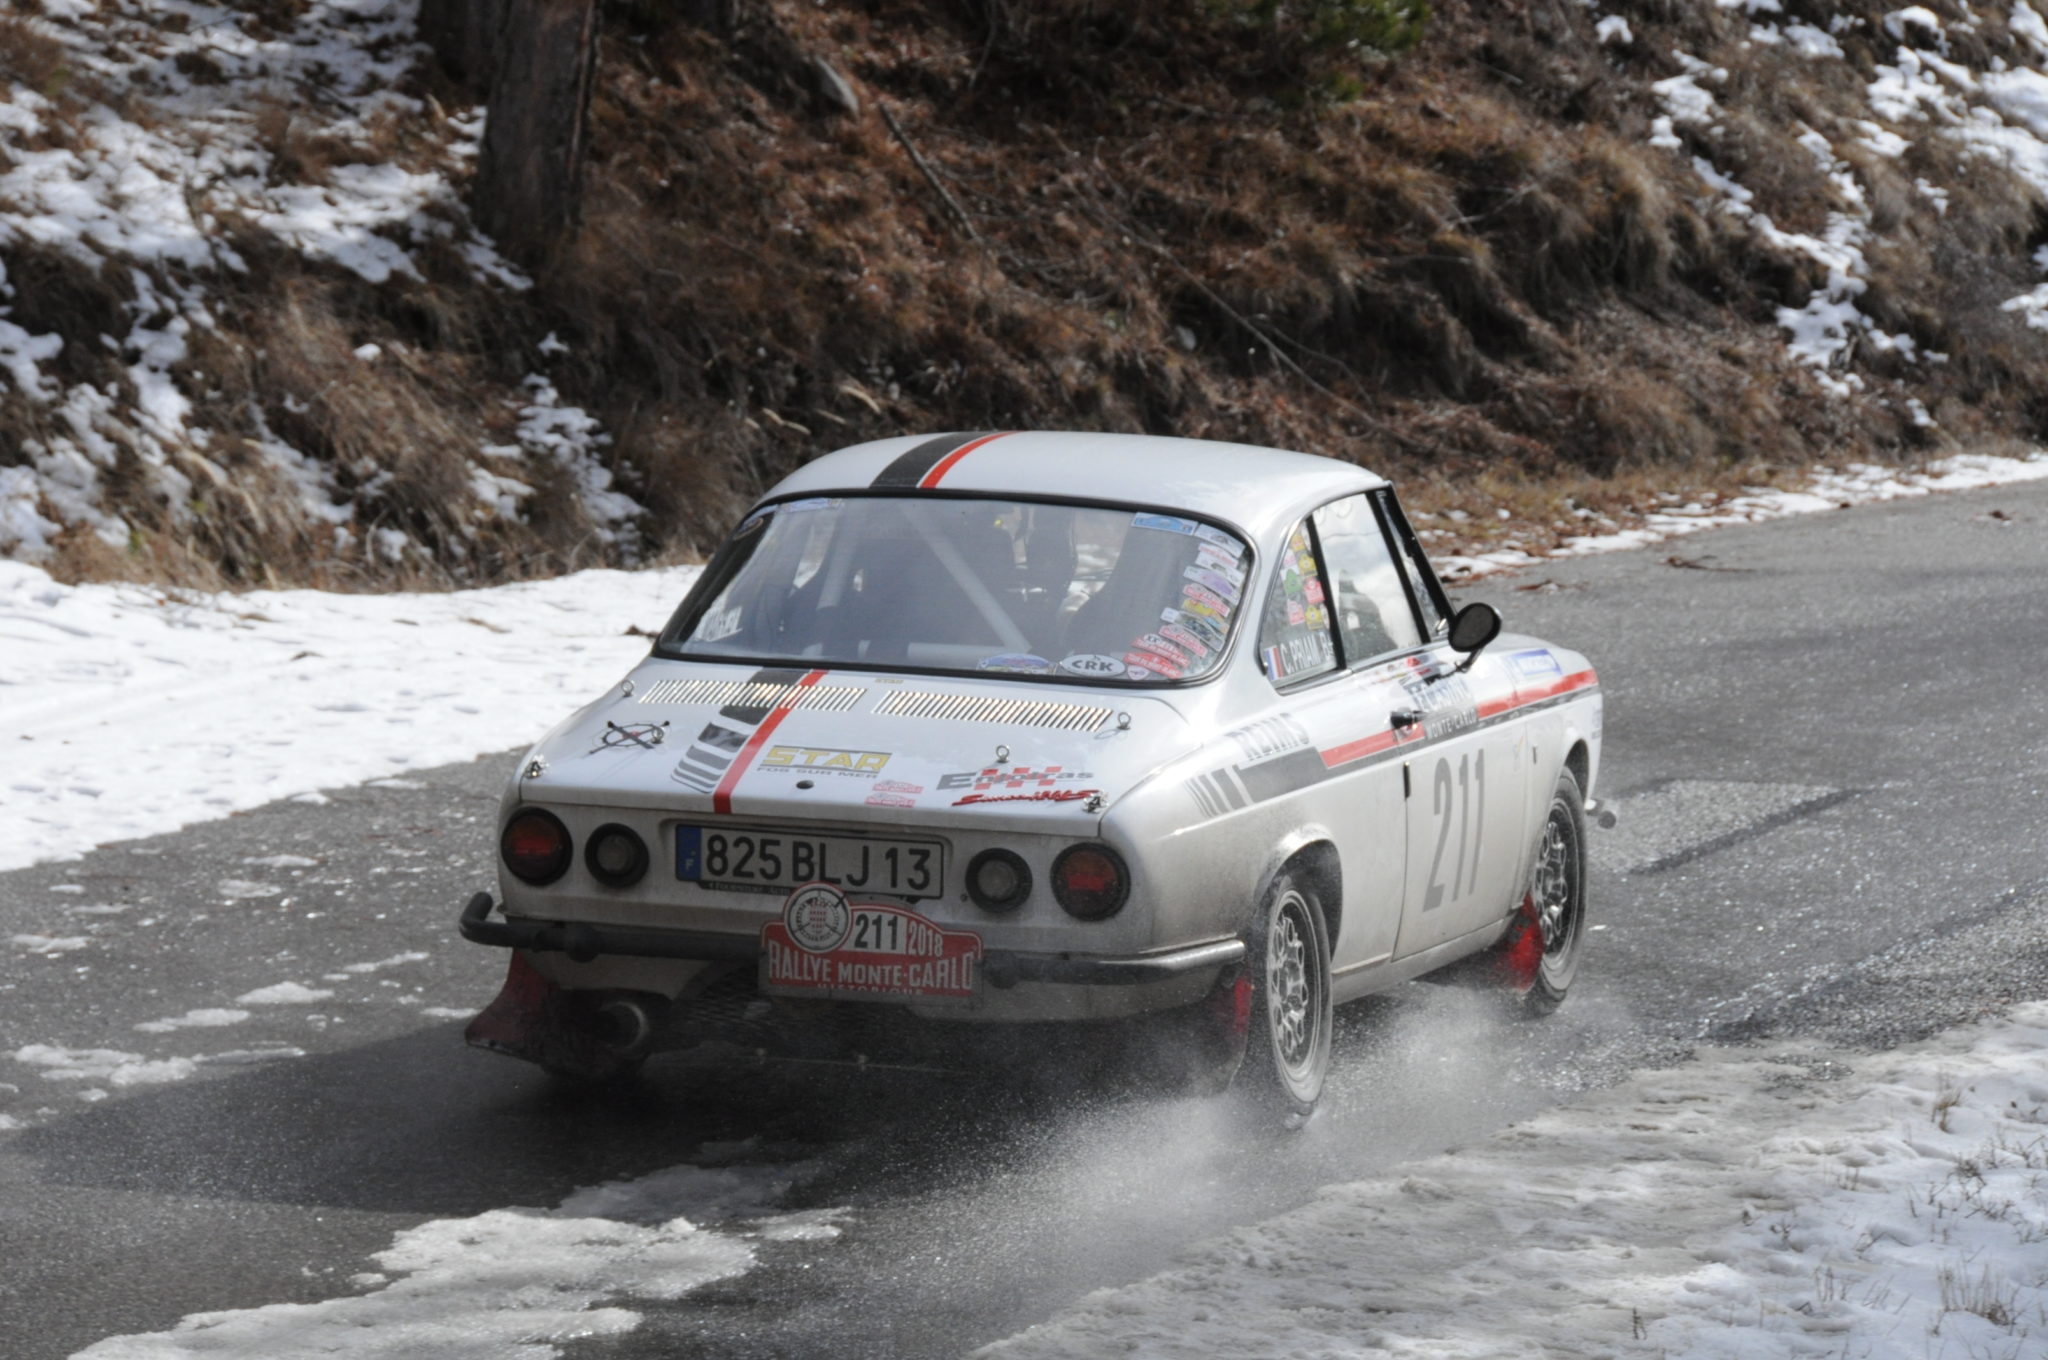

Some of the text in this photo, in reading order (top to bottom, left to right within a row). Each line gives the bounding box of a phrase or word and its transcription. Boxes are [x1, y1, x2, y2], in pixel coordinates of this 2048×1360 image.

[1071, 659, 1114, 672] CRK
[762, 746, 892, 772] STAR
[1422, 748, 1485, 913] 211
[706, 834, 931, 890] 825 BLJ 13
[854, 913, 898, 950] 211
[908, 921, 944, 957] 2018
[768, 938, 833, 982] RALLYE
